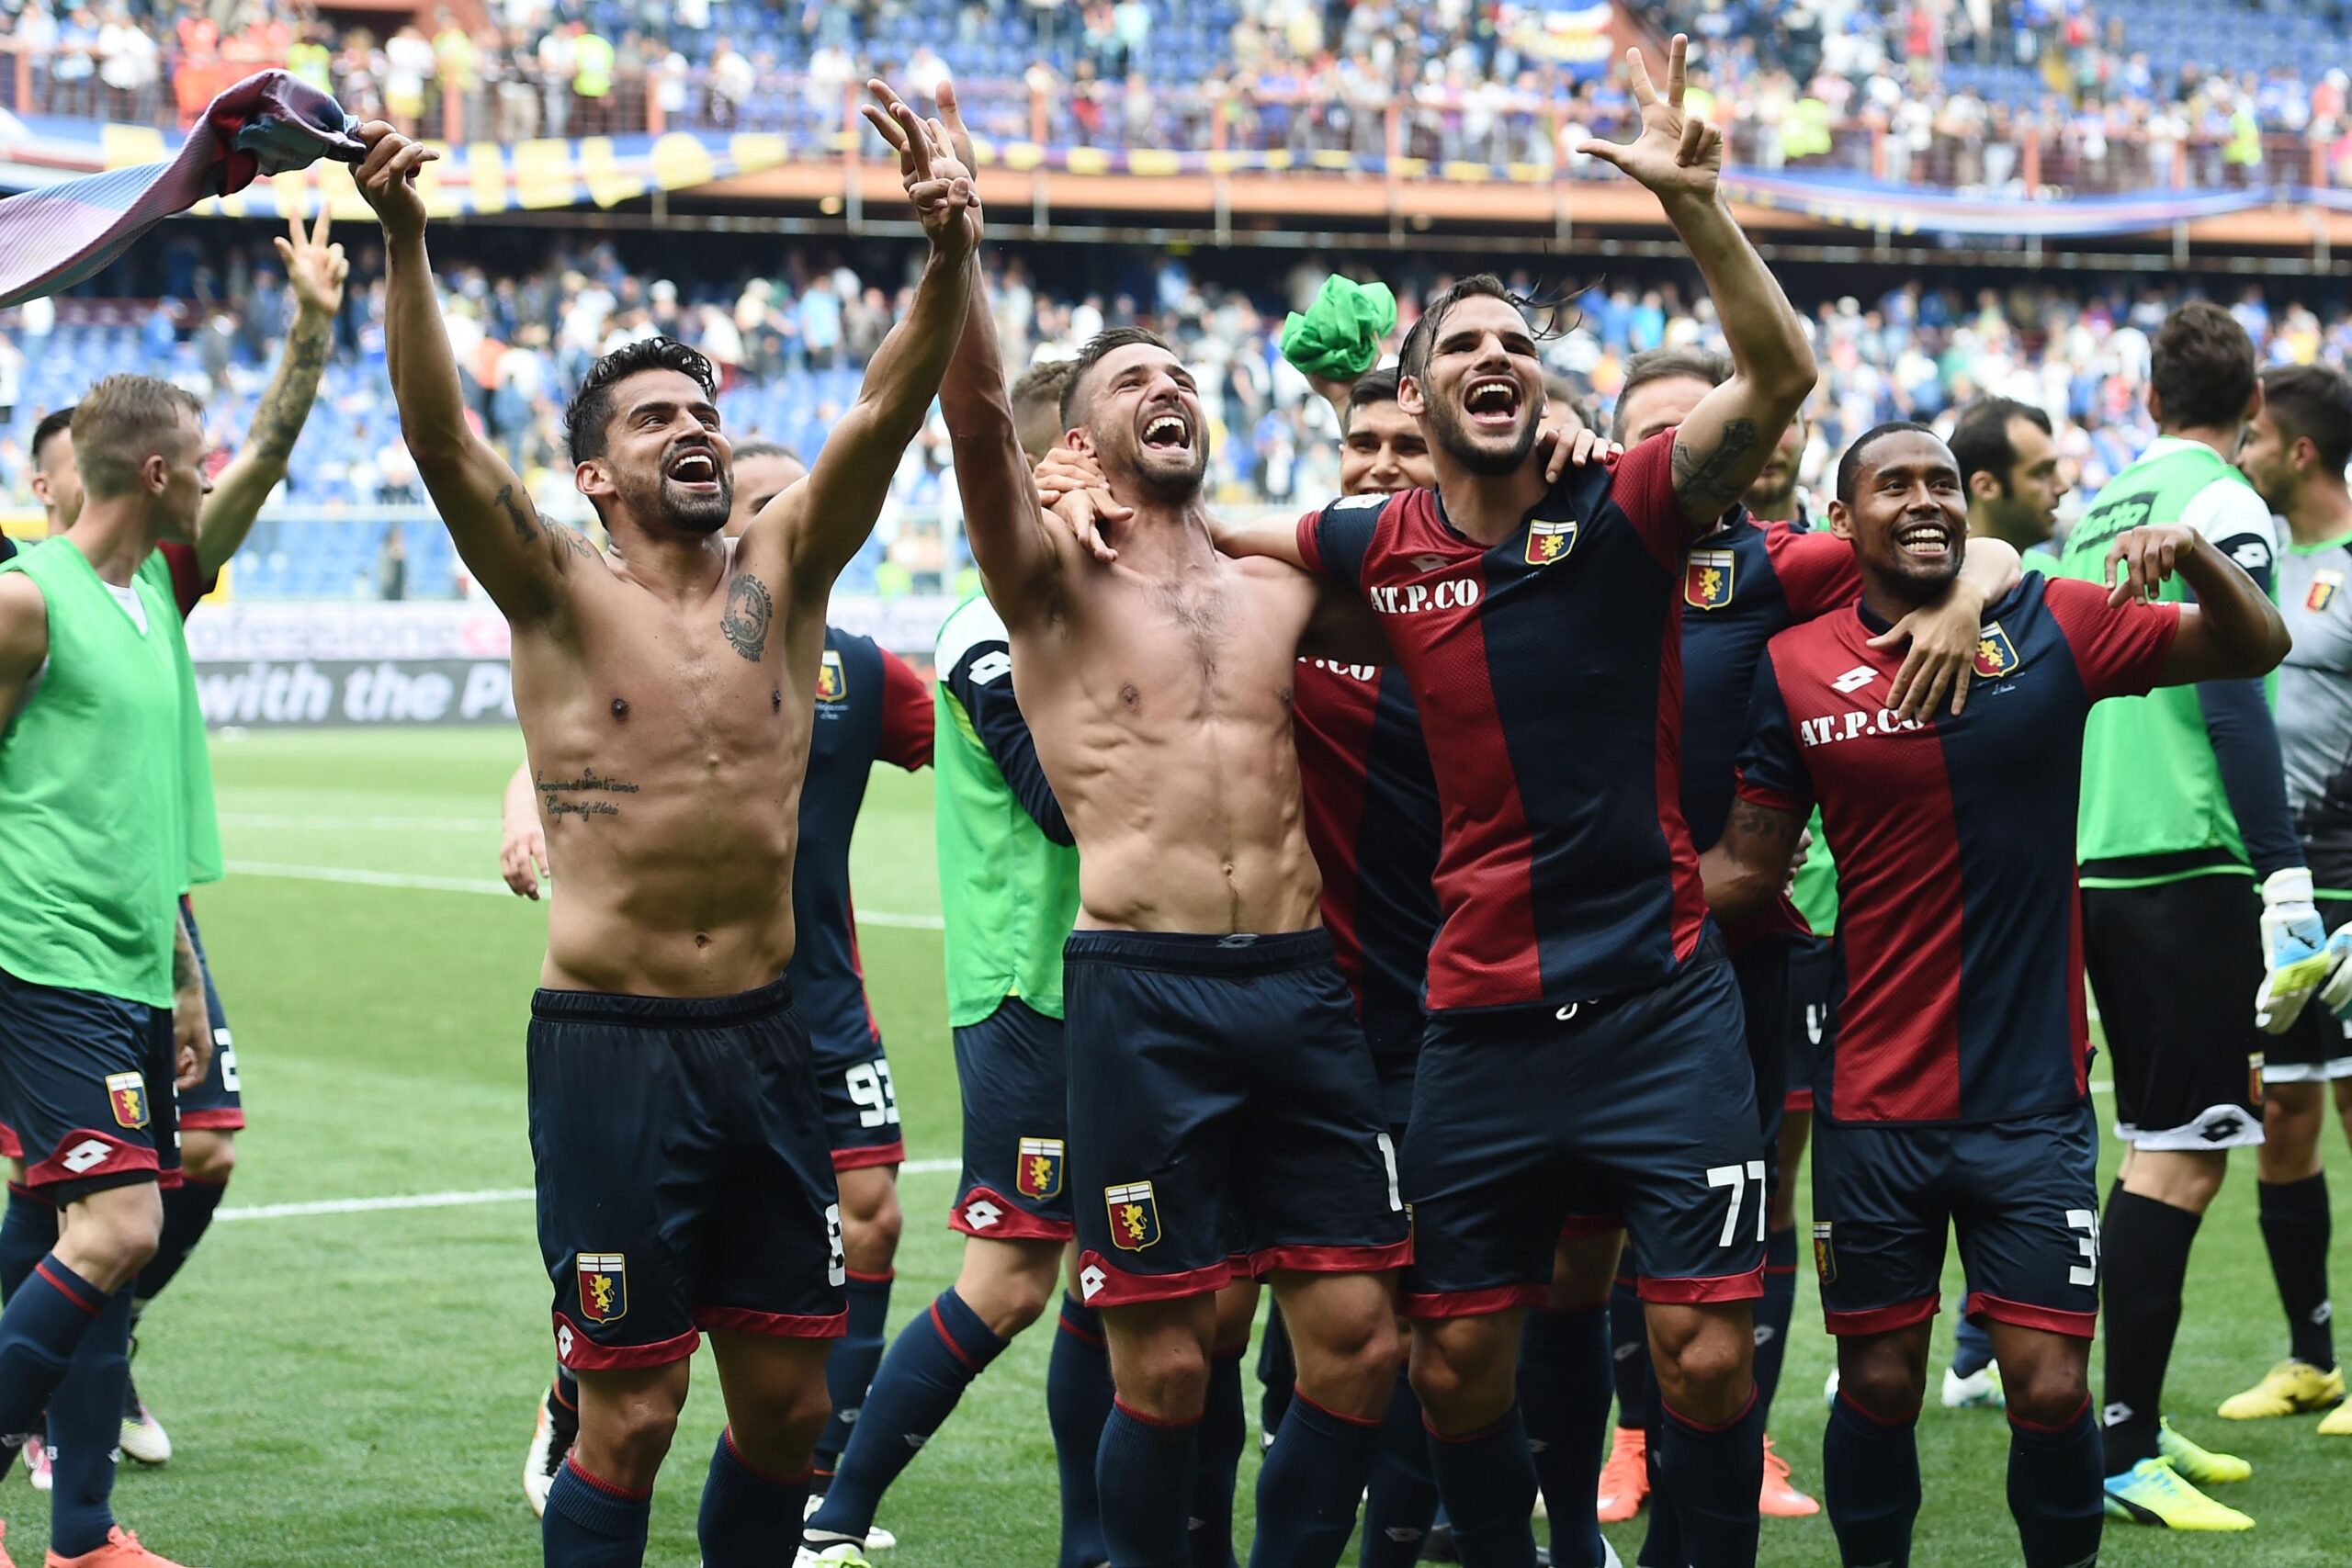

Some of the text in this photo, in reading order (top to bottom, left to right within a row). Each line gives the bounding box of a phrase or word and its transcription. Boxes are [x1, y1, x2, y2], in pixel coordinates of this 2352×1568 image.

[1370, 579, 1478, 614] AT.P.CO
[196, 660, 334, 722] with
[343, 661, 453, 722] the
[1706, 1160, 1767, 1247] 77
